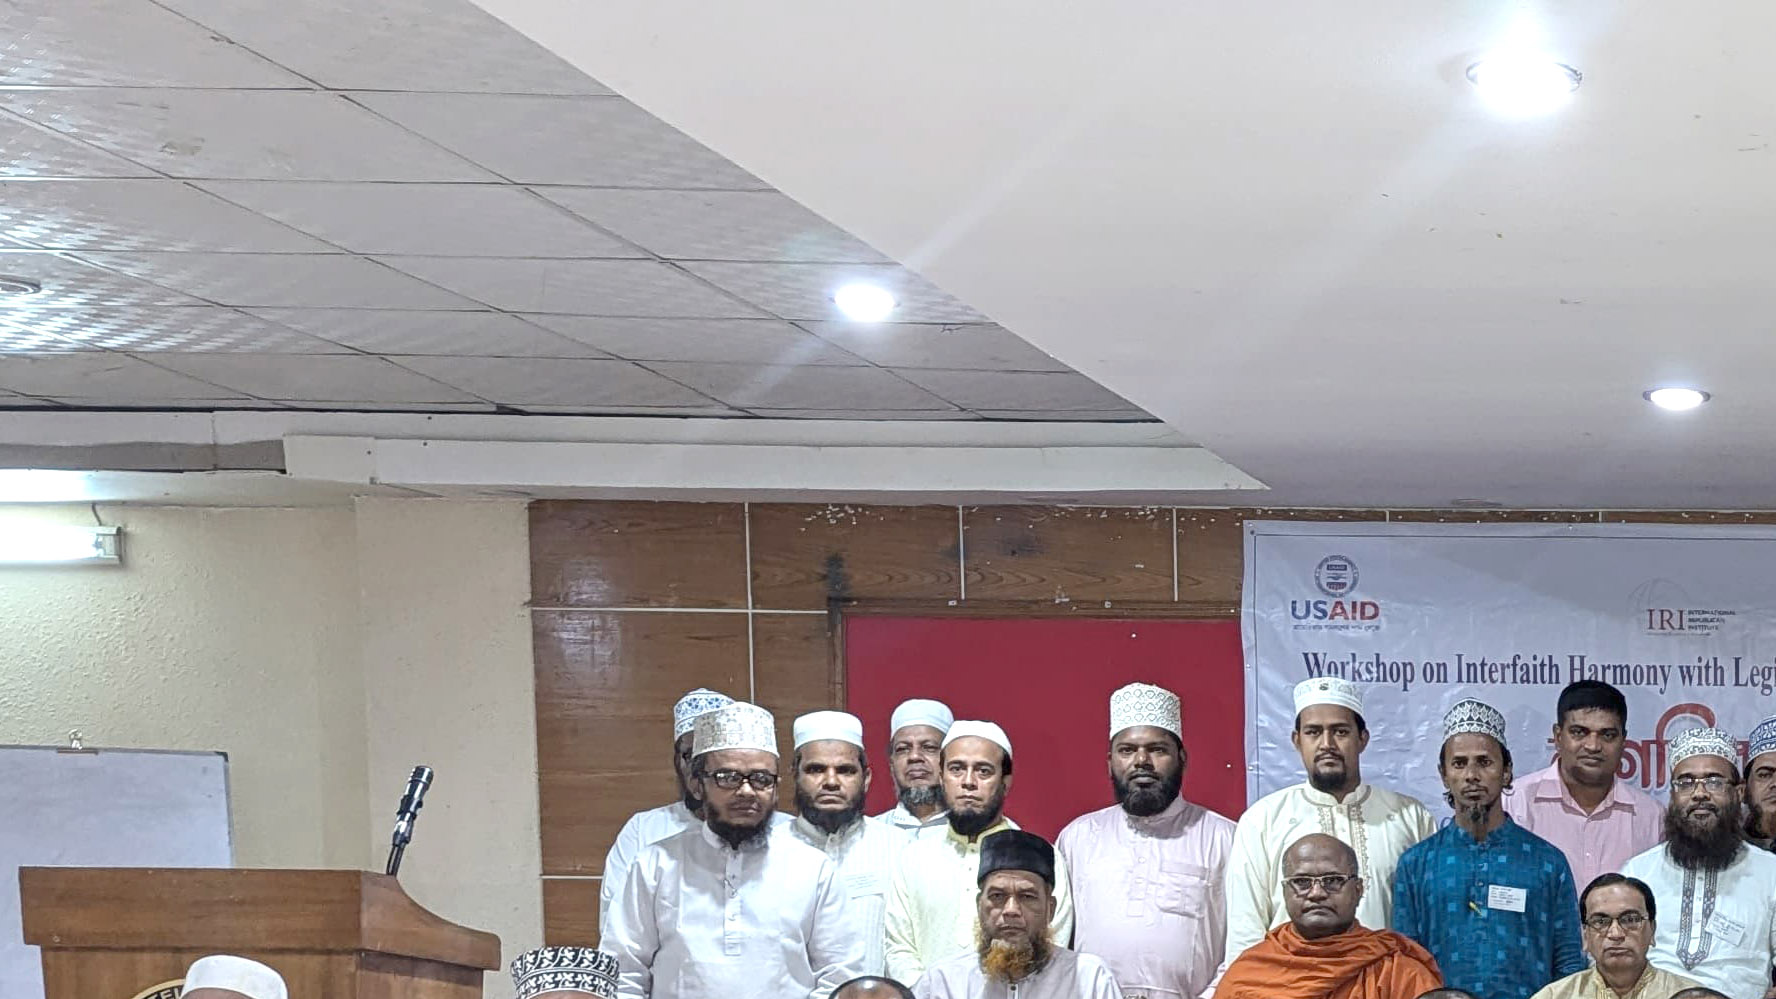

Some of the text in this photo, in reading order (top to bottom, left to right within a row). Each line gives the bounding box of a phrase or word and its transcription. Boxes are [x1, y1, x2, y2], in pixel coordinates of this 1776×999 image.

[1291, 600, 1380, 620] USAID
[1646, 608, 1686, 631] IRI
[1302, 651, 1416, 691] Workshop
[1422, 660, 1448, 684] on
[1455, 652, 1561, 685] Interfaith
[1567, 654, 1672, 694] Harmony
[1679, 656, 1726, 689] with
